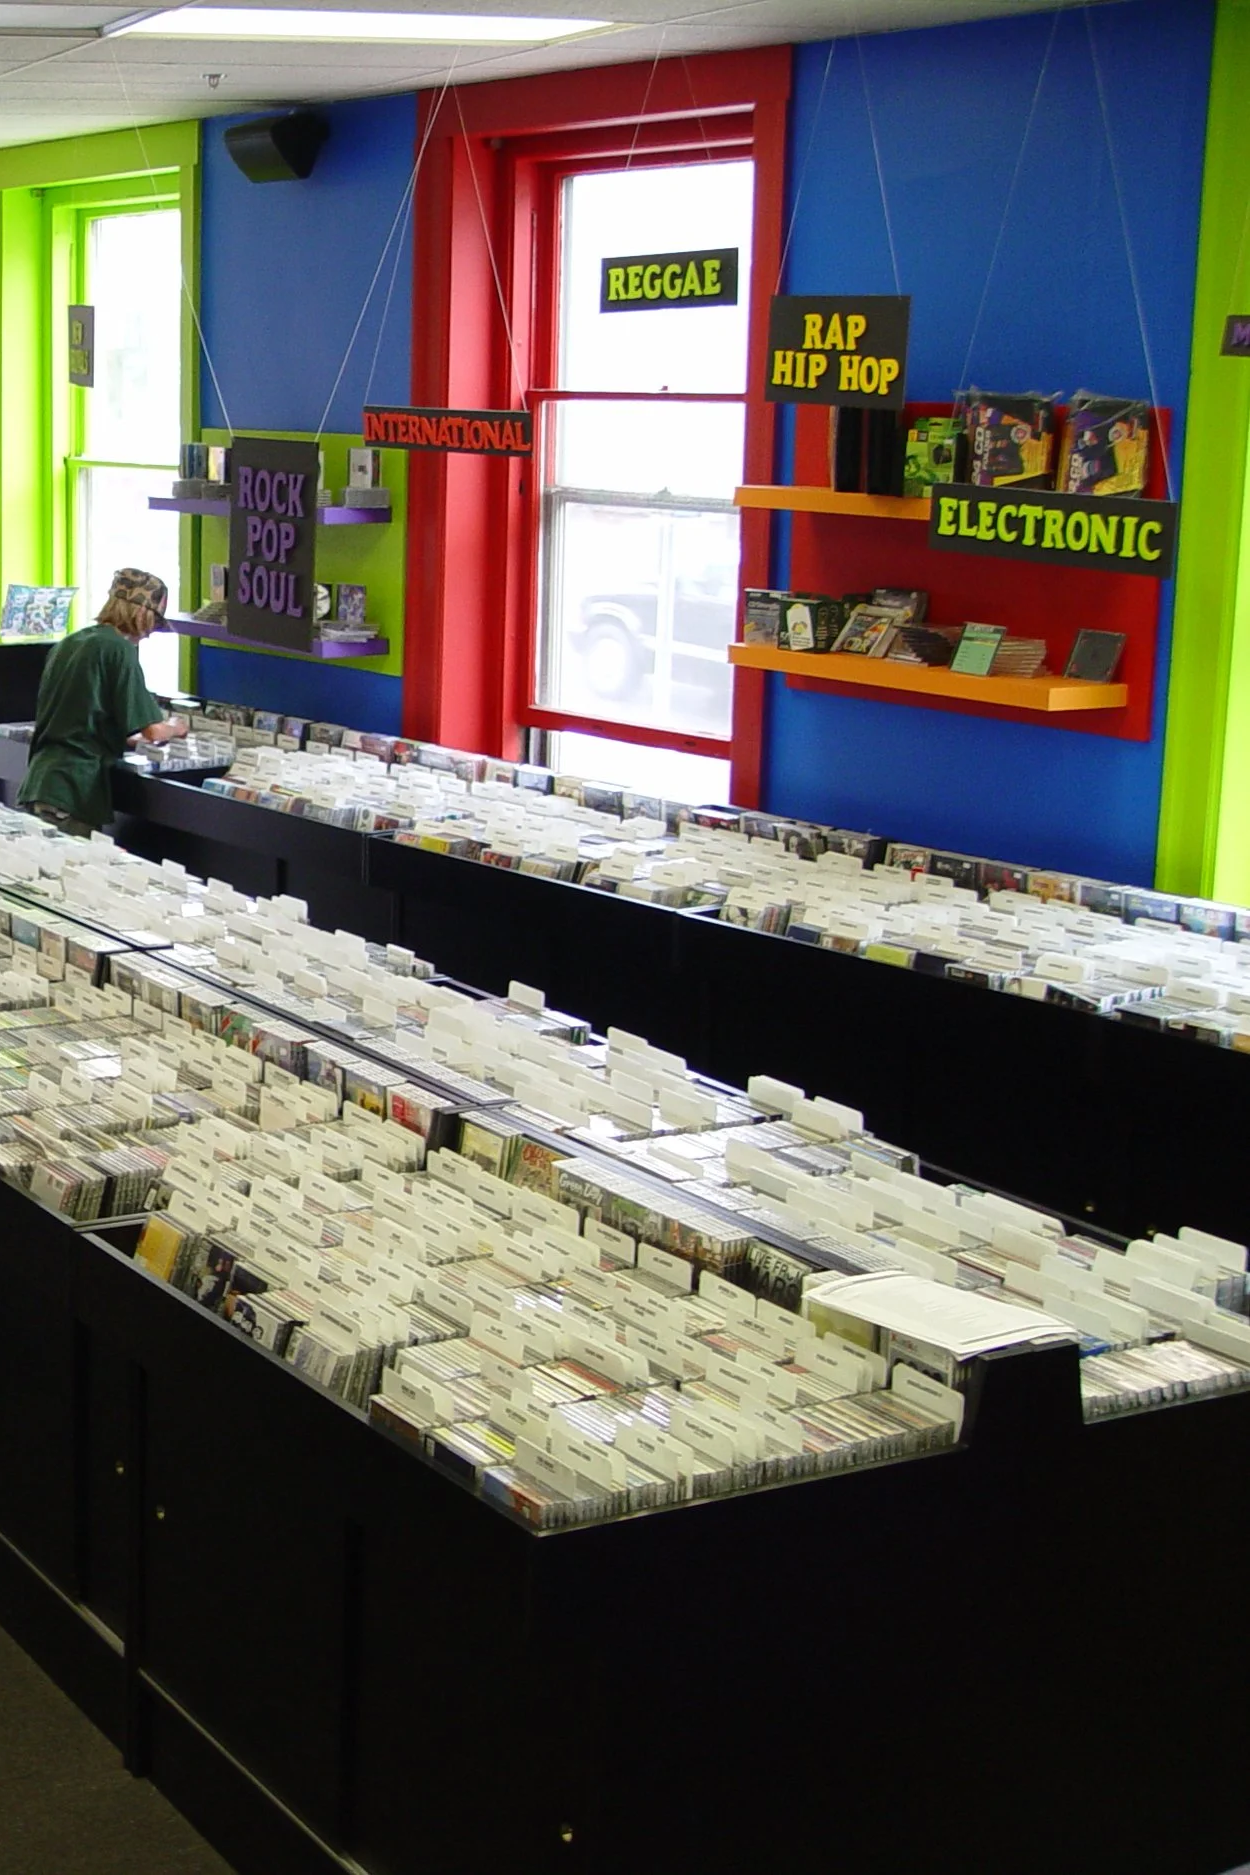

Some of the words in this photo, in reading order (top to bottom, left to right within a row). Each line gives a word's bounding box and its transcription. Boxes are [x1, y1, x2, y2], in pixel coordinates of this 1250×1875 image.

[608, 259, 721, 301] REGGAE
[802, 312, 866, 350] RAP
[772, 350, 827, 388] HIP
[838, 354, 899, 395] HOP
[363, 412, 532, 451] INTERNATIONAL
[237, 466, 305, 518] ROCK
[247, 516, 295, 564] POP
[937, 496, 1162, 561] ELECTRONIC
[237, 561, 303, 618] SOUL
